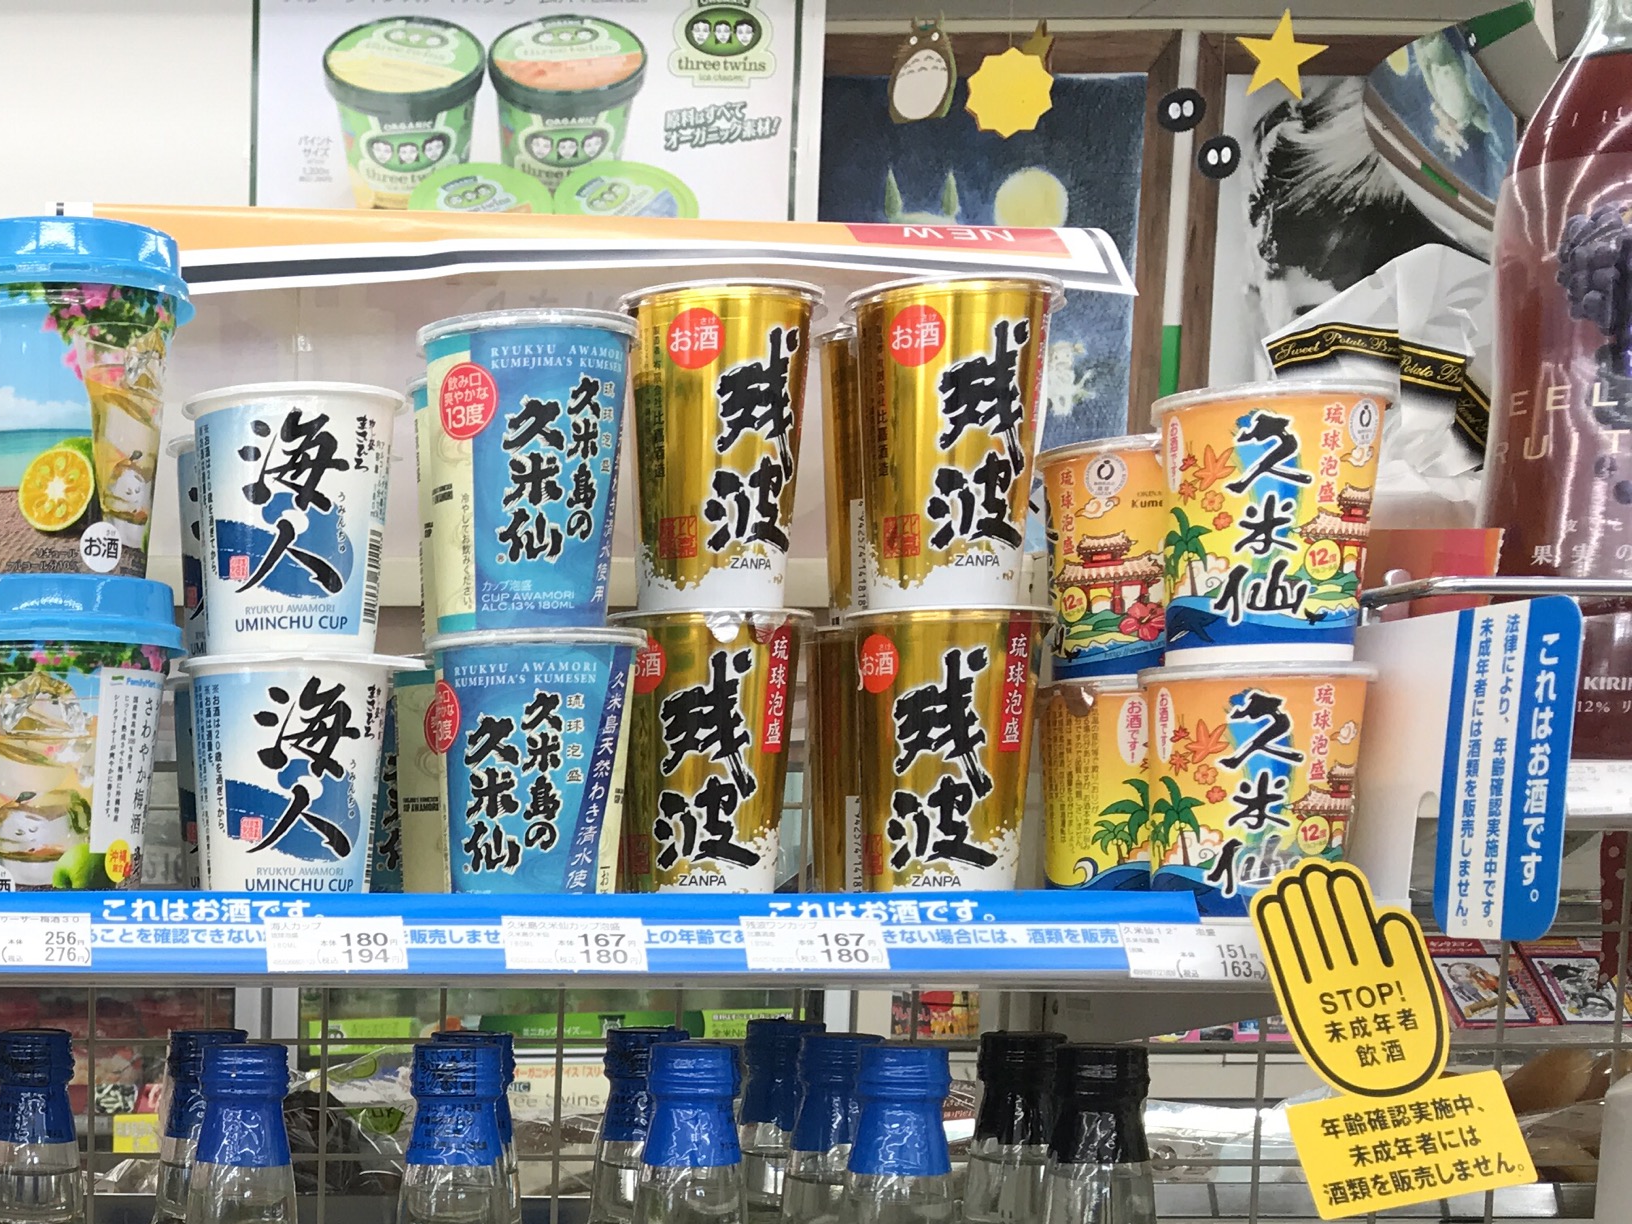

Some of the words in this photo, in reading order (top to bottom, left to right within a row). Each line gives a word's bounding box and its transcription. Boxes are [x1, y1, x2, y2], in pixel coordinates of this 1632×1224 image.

[722, 57, 766, 72] twins
[669, 326, 719, 352] お酒
[891, 320, 941, 349] お酒
[491, 345, 556, 357] RYUKYU
[491, 357, 573, 369] KUMEJIMA'S
[448, 373, 482, 391] 飲み口
[444, 387, 488, 405] 爽やかな
[446, 405, 485, 429] 13度
[567, 375, 601, 541] 久米島の
[1317, 406, 1346, 503] 琉球泡盛
[498, 396, 565, 564] 久米仙
[235, 407, 349, 593] 海人
[1215, 412, 1313, 626] 久米仙
[84, 536, 120, 559] お酒
[954, 554, 1000, 567] ZANPA
[730, 555, 772, 570] ZANPA
[482, 580, 532, 592] カップ泡盛
[482, 593, 510, 603] CUP
[512, 591, 575, 601] AWAMORI
[245, 605, 283, 614] RYUKYU
[287, 604, 335, 613] AWAMORI
[482, 602, 535, 612] ALC.13%
[538, 601, 575, 610] 180ML
[235, 616, 313, 632] UMINCHU
[318, 615, 348, 630] CUP
[454, 663, 509, 677] RYUKYU
[521, 661, 597, 672] AWAMORI
[454, 674, 526, 688] KUMEJIMA'S
[534, 674, 597, 684] KUMESEN
[765, 637, 788, 745] 琉球泡盛
[1001, 635, 1028, 743] 琉球泡盛
[1309, 684, 1335, 782] 琉球泡盛
[246, 676, 360, 858] 海人
[522, 691, 563, 851] 久米島の
[1455, 617, 1495, 929] 未成年者には酒類を販売しません。
[1520, 631, 1562, 904] これはお酒です。
[464, 714, 522, 874] 久米仙
[256, 867, 296, 876] RYUKYU
[298, 867, 343, 876] AWAMORI
[679, 875, 727, 886] ZANPA
[911, 875, 961, 887] ZANPA
[245, 878, 324, 892] UMINCHU
[329, 878, 354, 892] CUP
[1320, 984, 1407, 1014] STOP!
[1324, 1010, 1420, 1043] 未成年者
[1354, 1039, 1407, 1068] 飲酒
[1320, 1094, 1487, 1140] 年齢確認実施中、
[1348, 1125, 1483, 1167] 未成年者には
[1323, 1161, 1526, 1206] 酒類を販売しません。
